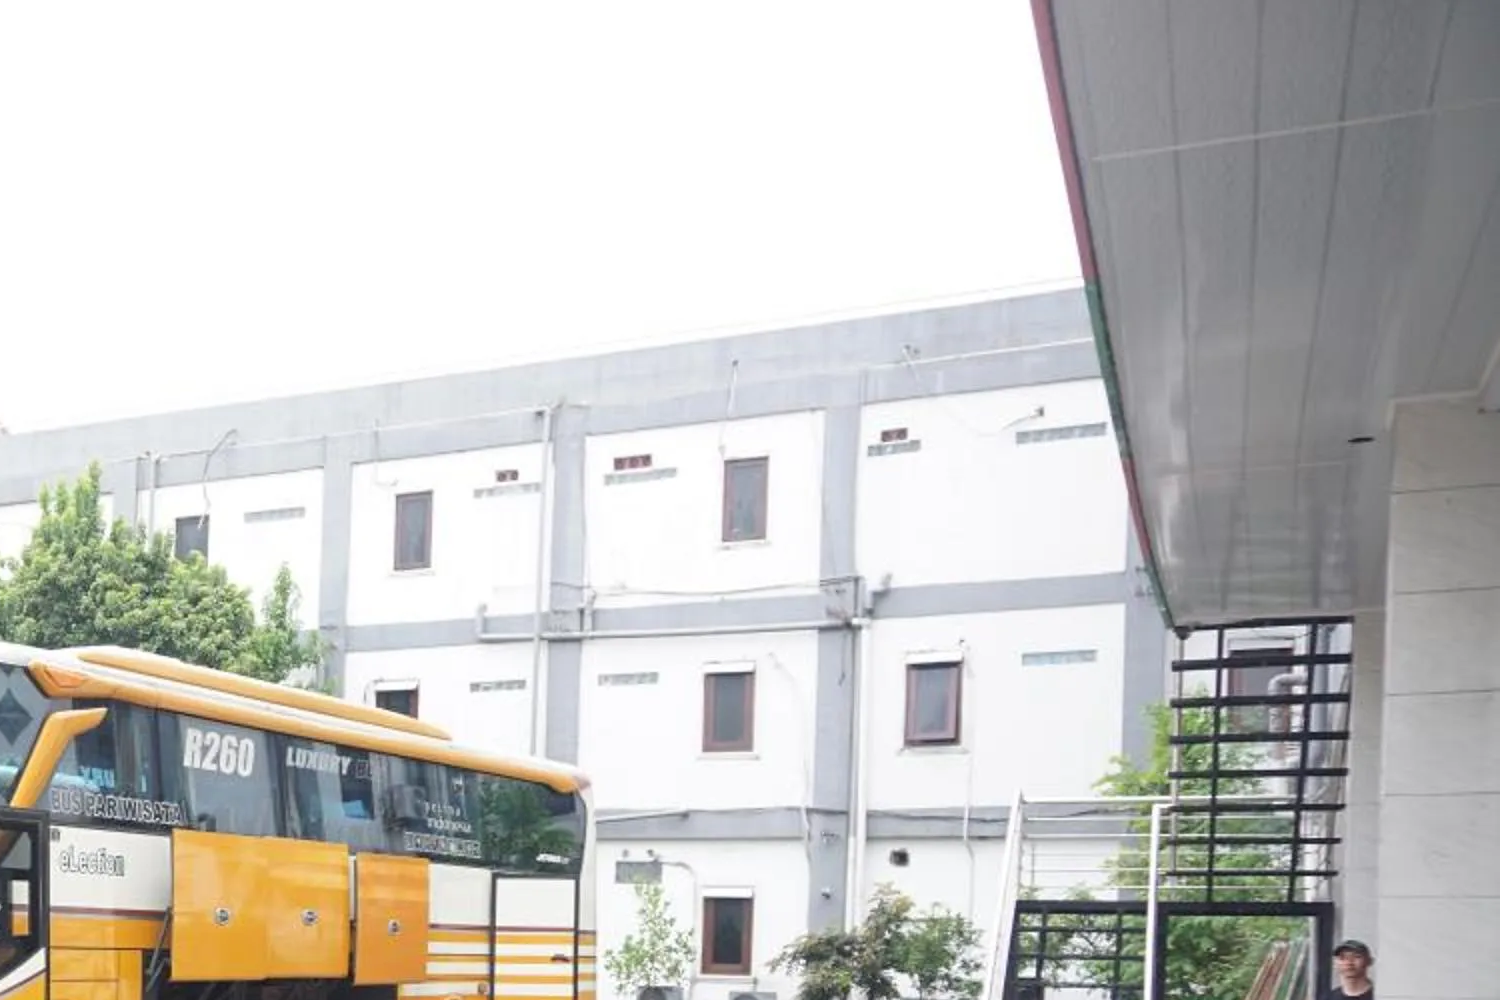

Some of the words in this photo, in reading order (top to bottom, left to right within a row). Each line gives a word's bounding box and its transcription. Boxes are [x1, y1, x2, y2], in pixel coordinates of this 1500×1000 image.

[183, 727, 255, 777] R260
[286, 746, 352, 776] LUXURY
[50, 786, 82, 816] BUS
[84, 791, 186, 826] PARIWISATA
